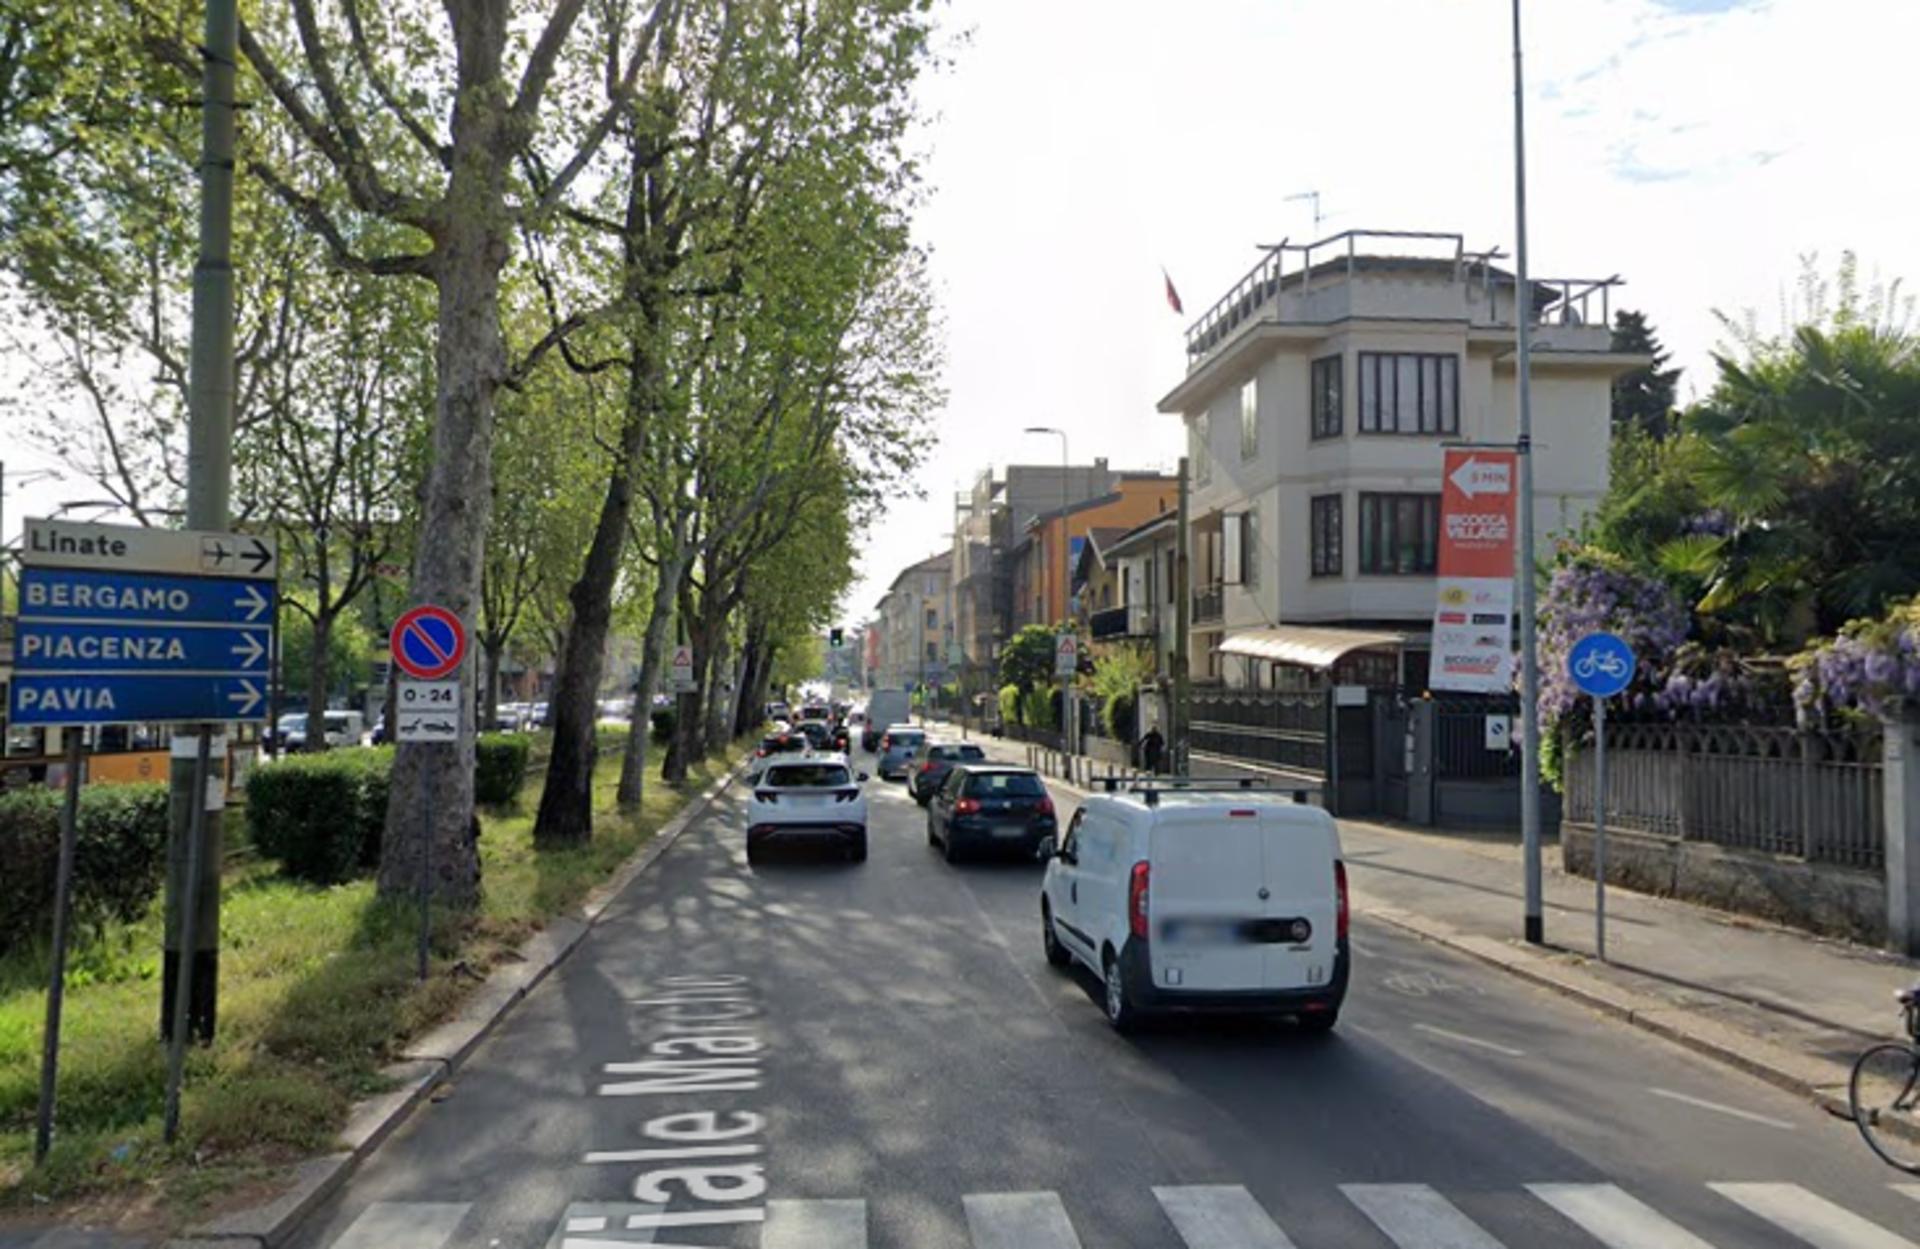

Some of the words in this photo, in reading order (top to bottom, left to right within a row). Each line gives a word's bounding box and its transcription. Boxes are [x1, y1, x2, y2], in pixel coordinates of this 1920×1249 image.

[31, 529, 127, 556] Linate
[26, 582, 190, 611] BERGAMO
[21, 634, 186, 660] PIACENZA
[17, 687, 116, 711] PAVIA
[430, 689, 452, 701] 24
